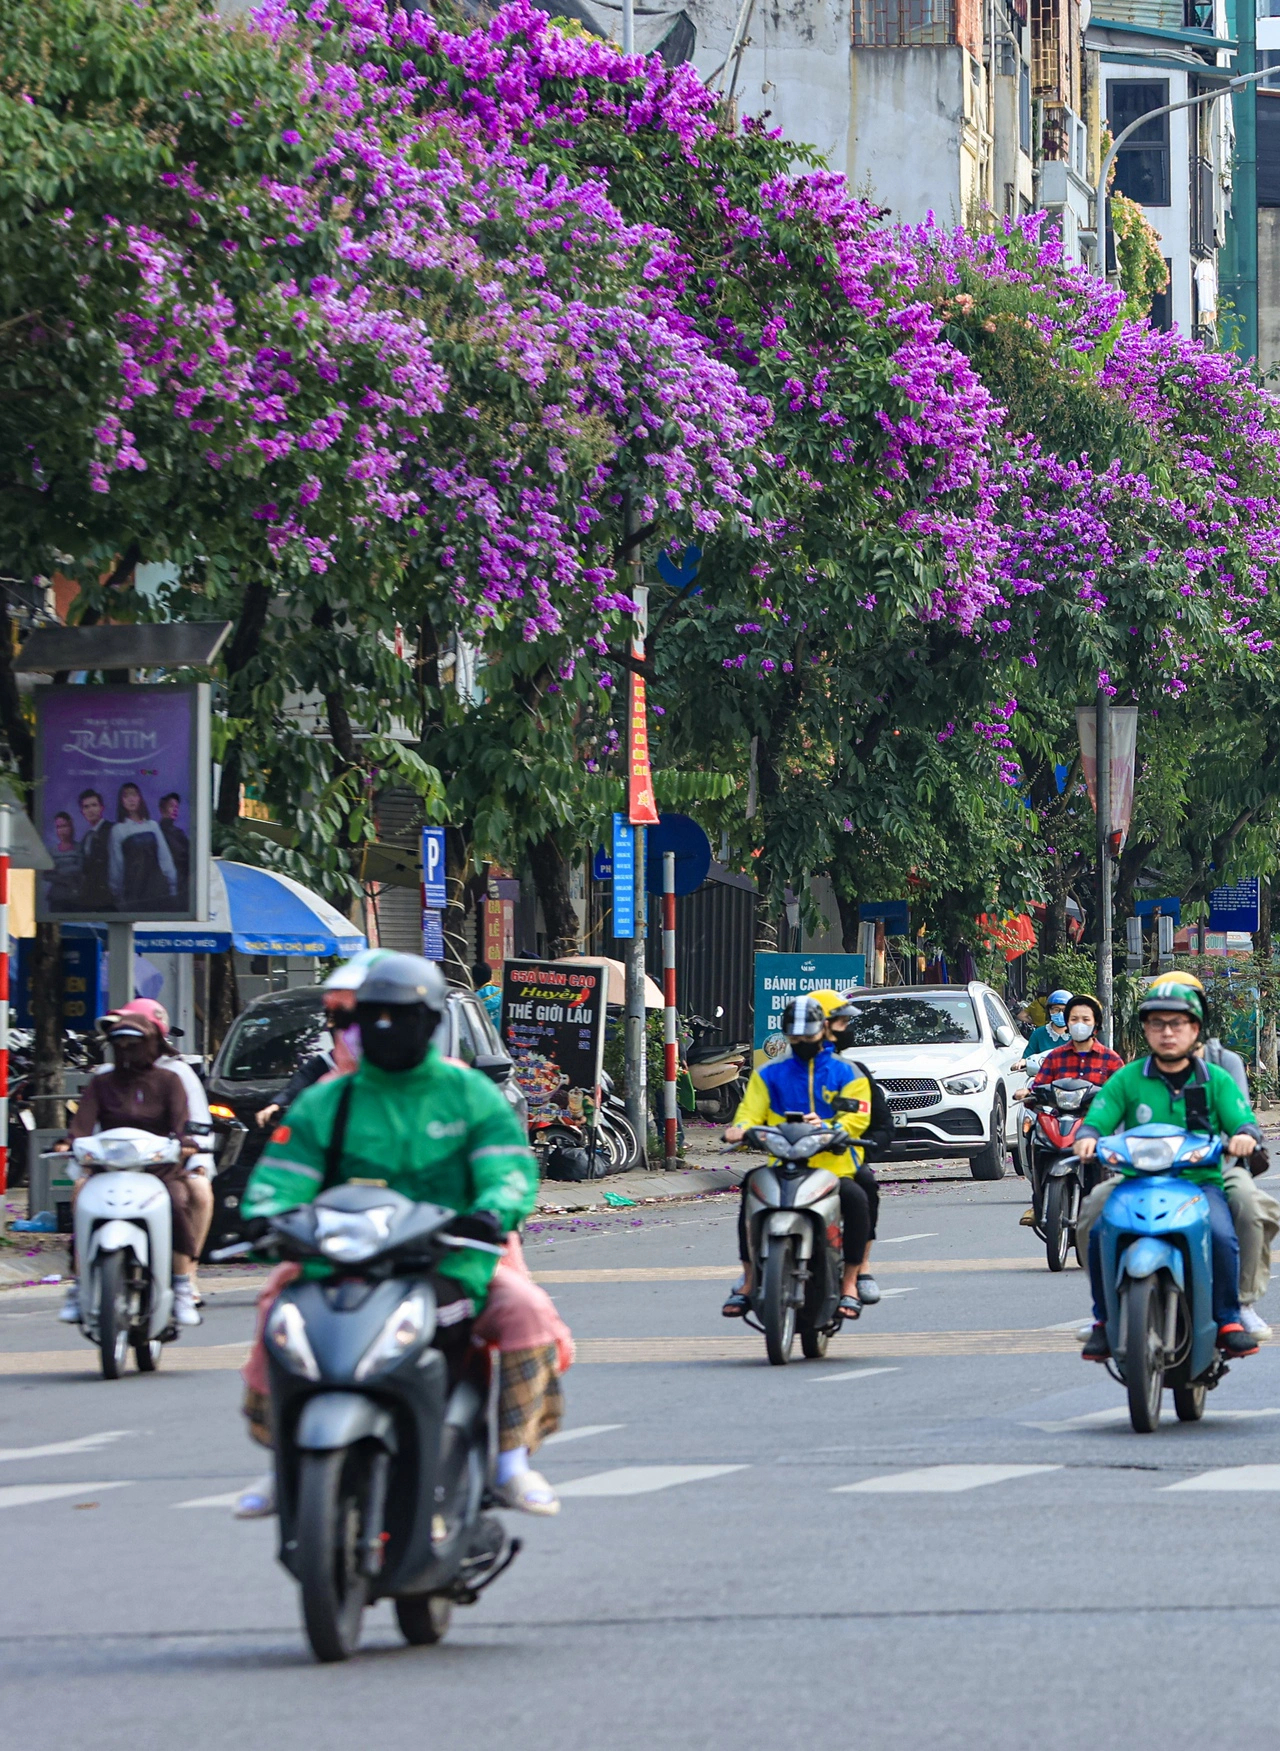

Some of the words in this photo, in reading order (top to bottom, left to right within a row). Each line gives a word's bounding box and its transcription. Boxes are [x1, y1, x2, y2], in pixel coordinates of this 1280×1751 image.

[428, 837, 440, 882] P
[510, 969, 537, 984] 65A
[538, 970, 567, 985] VĂN
[569, 974, 597, 989] CAO
[763, 975, 797, 991] BÁNH
[799, 978, 832, 991] CANH
[834, 975, 859, 991] HUẾ
[520, 986, 583, 1000] Huyền
[508, 1000, 534, 1020] THẾ
[535, 1003, 564, 1023] GIỚI
